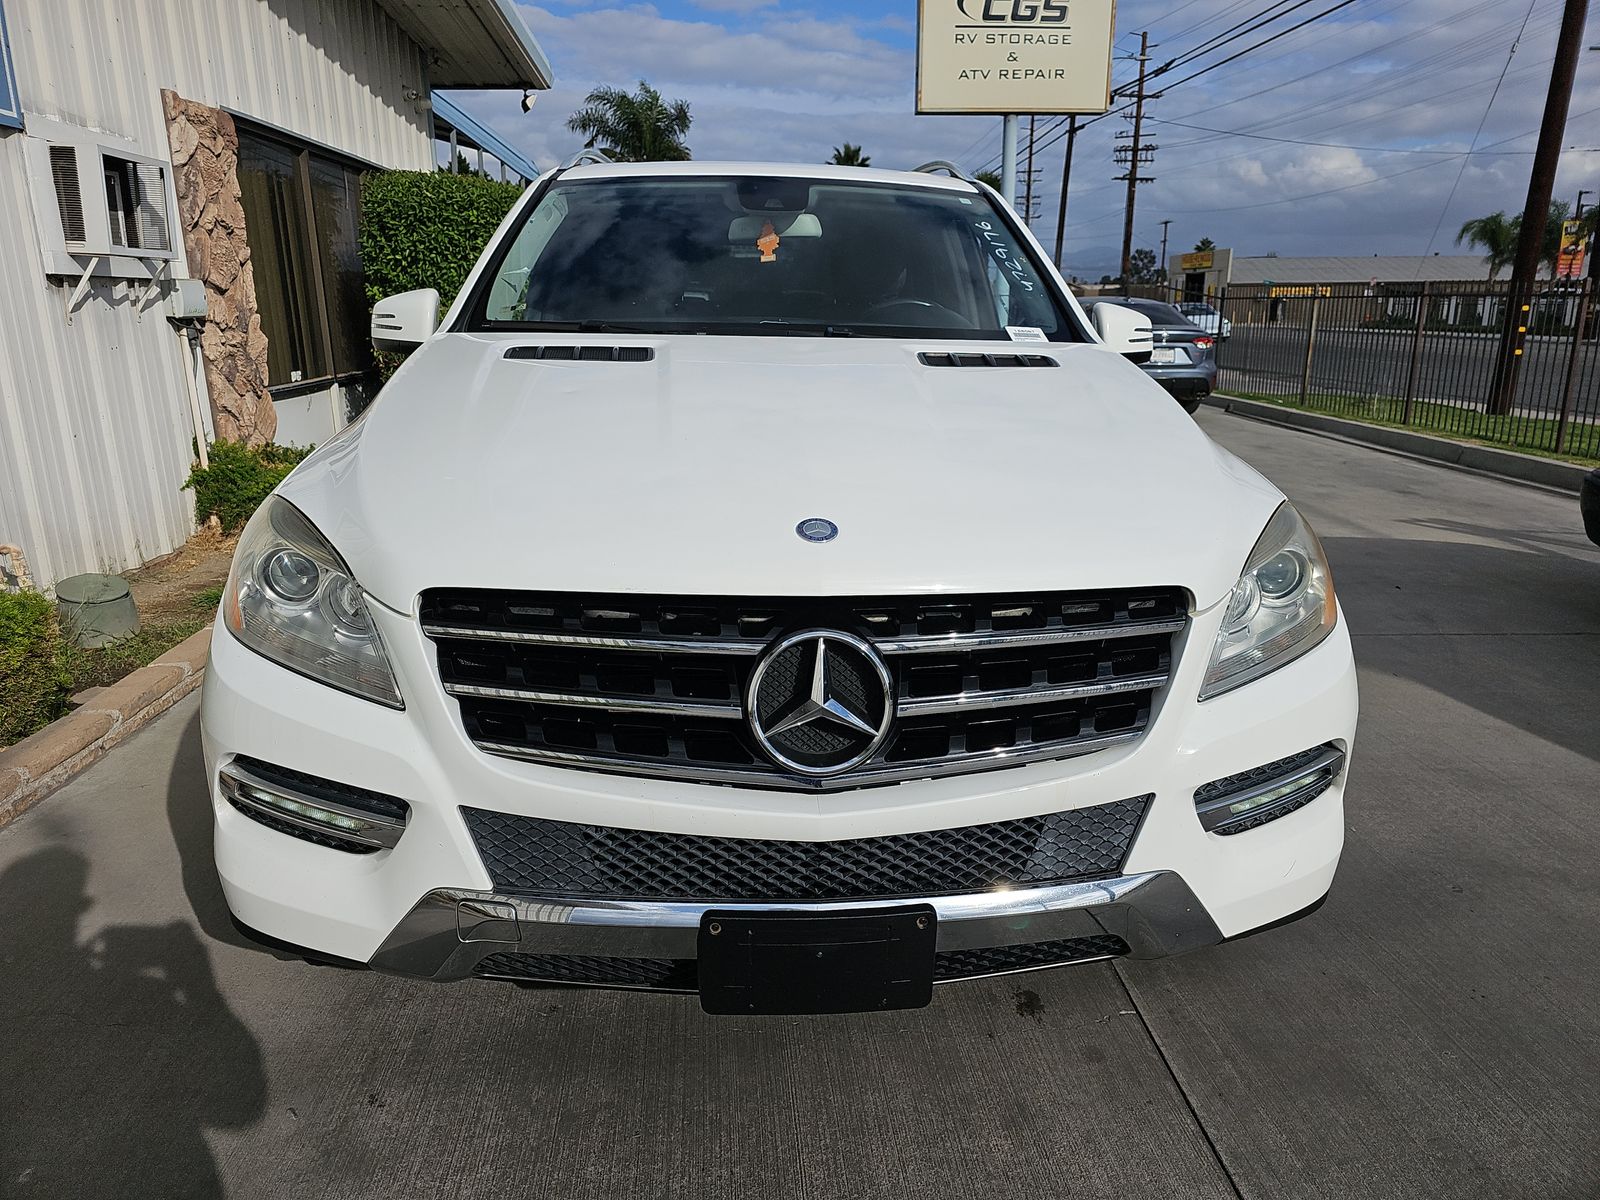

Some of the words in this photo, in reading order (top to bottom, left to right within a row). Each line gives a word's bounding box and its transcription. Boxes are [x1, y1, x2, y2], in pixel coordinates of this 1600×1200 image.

[982, 0, 1069, 23] CGS
[954, 33, 978, 45] RV
[985, 33, 1072, 45] STORAGE
[1006, 51, 1019, 62] &
[958, 69, 991, 80] ATV
[999, 68, 1065, 80] REPAIR
